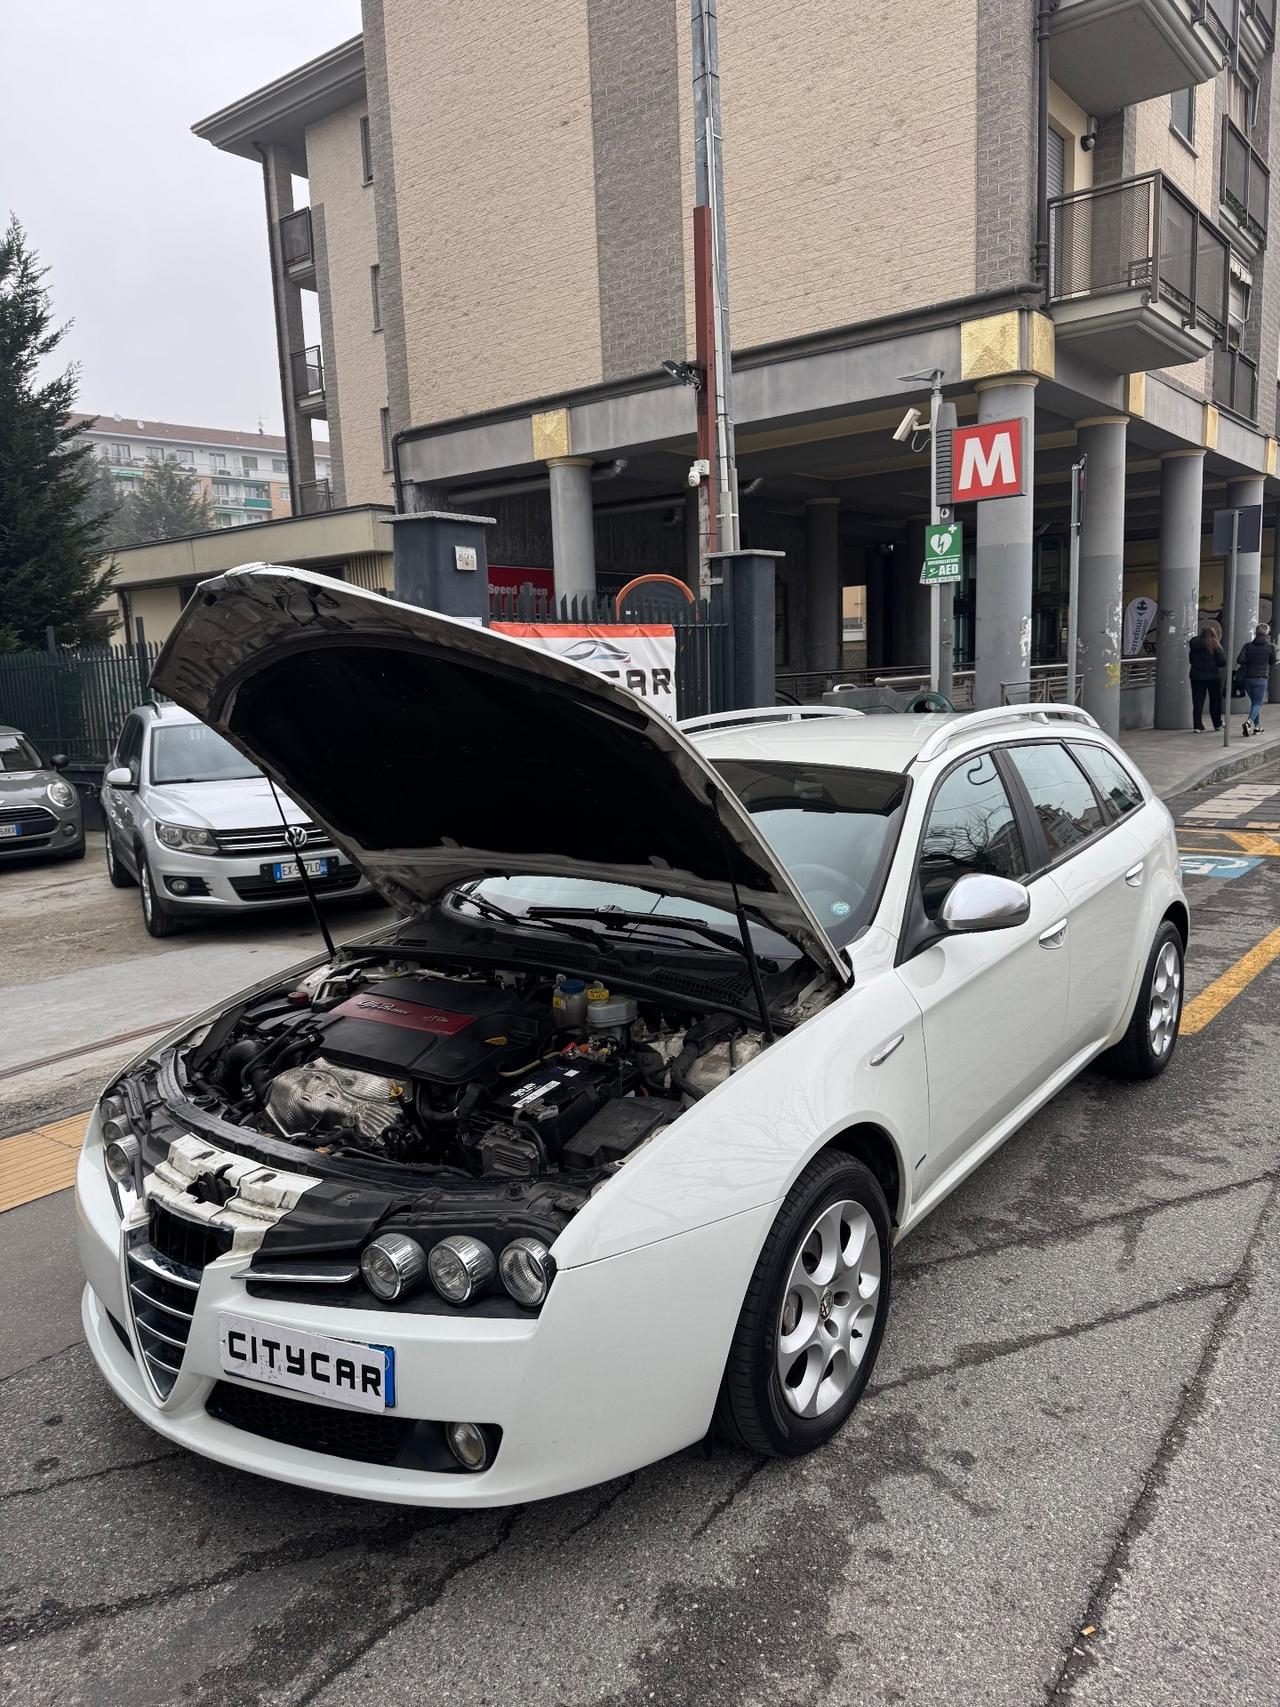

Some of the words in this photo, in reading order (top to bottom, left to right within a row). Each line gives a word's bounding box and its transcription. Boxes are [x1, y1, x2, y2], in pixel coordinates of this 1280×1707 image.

[958, 432, 1017, 490] M
[938, 563, 959, 576] AED
[227, 1330, 382, 1397] CITYCAR
